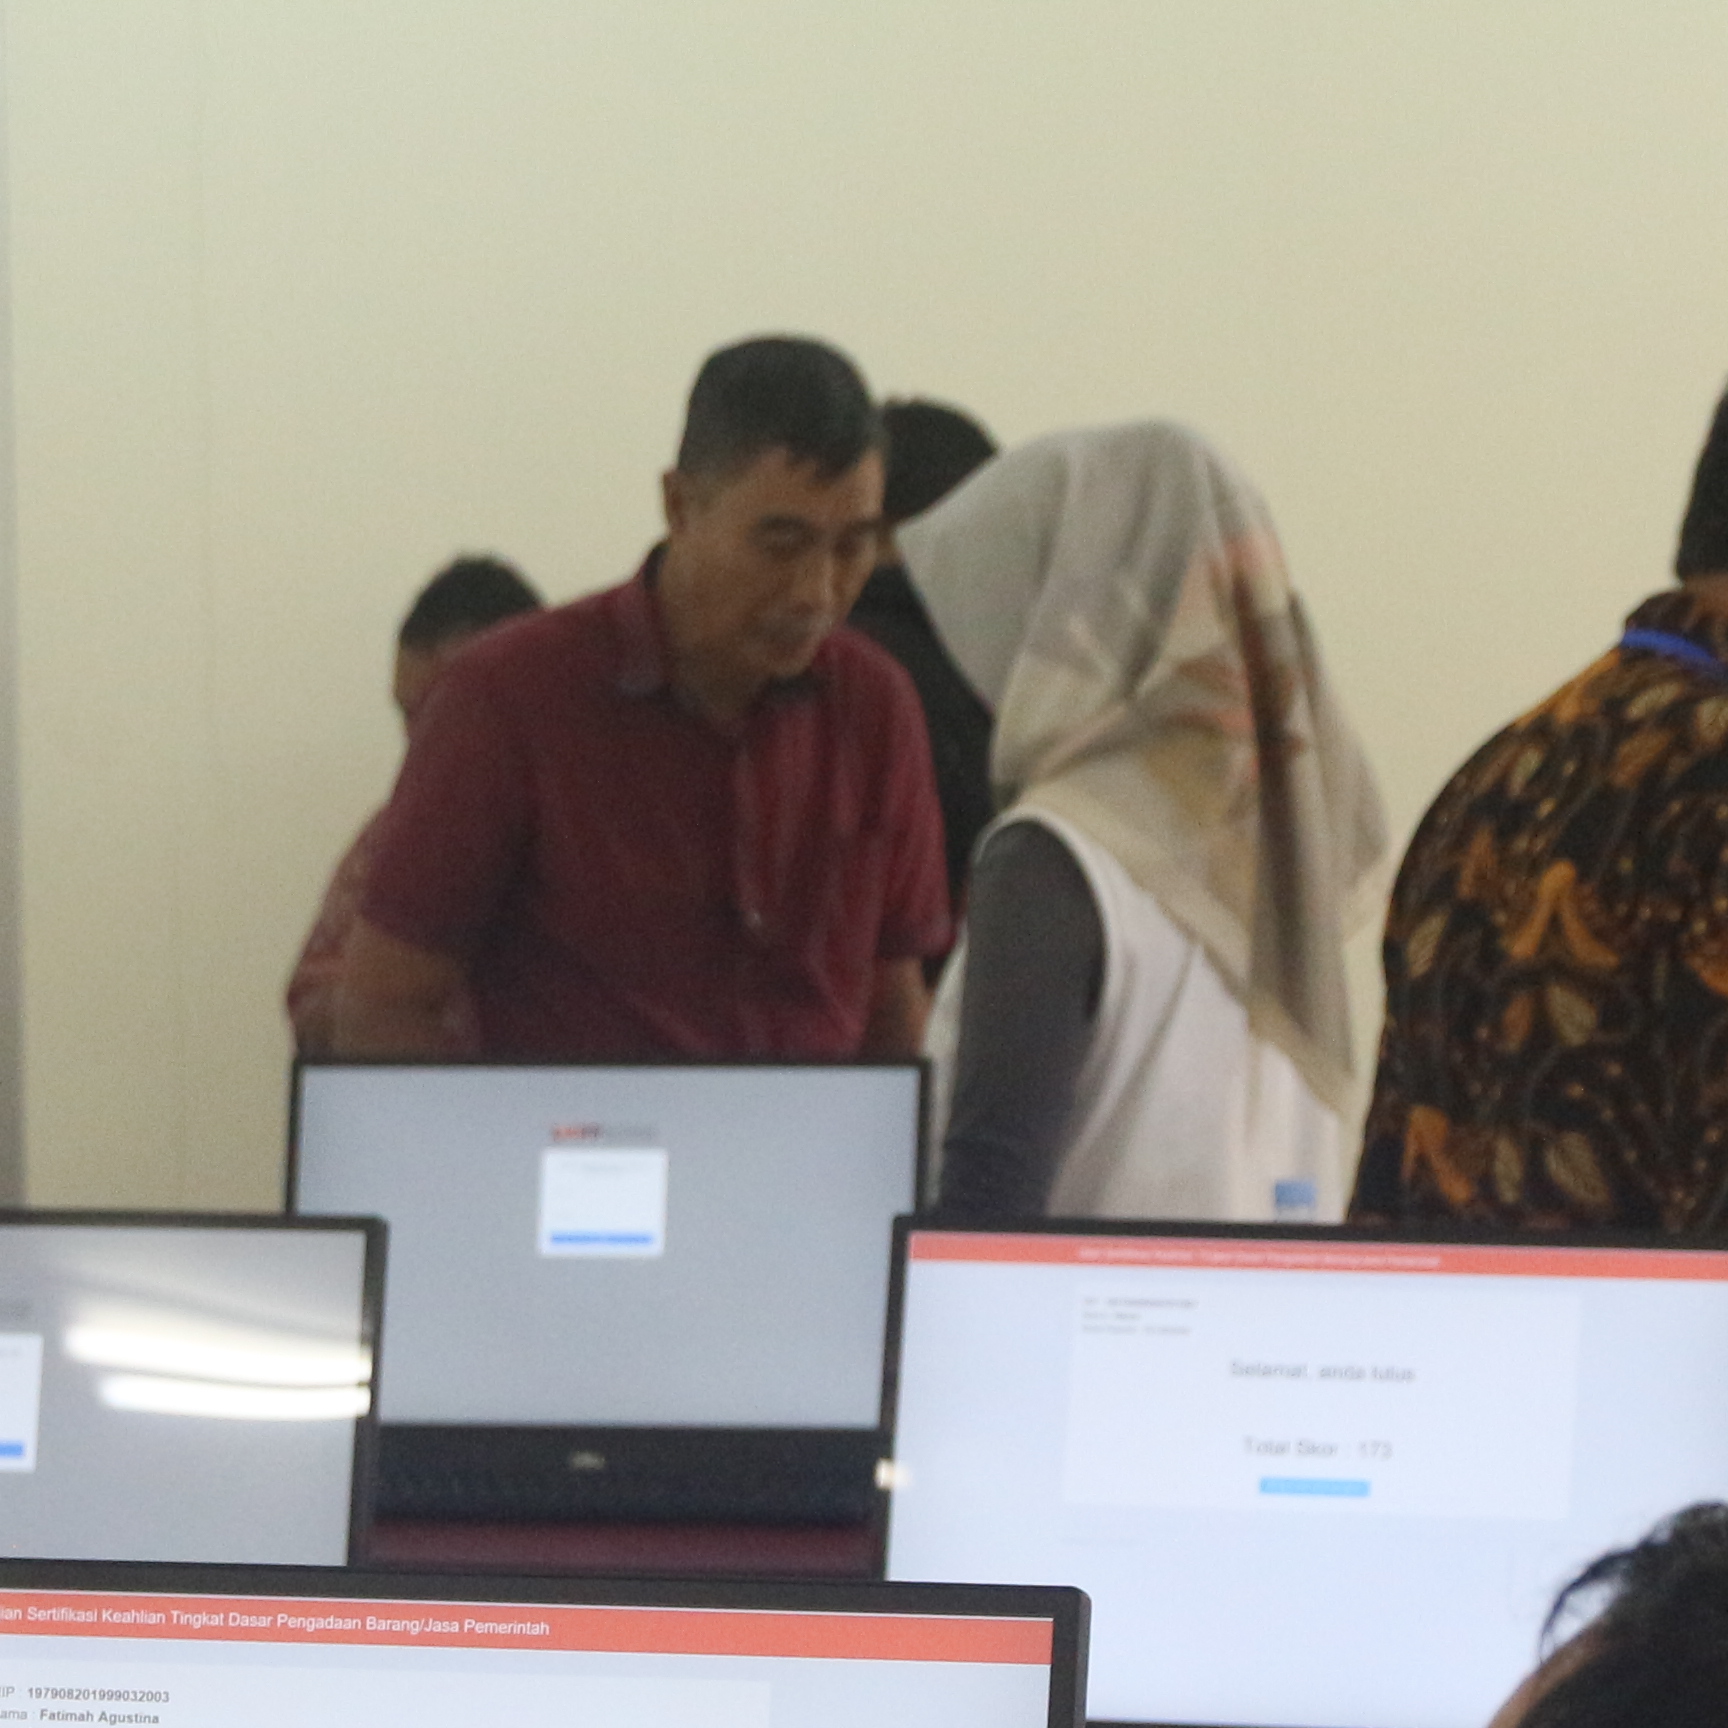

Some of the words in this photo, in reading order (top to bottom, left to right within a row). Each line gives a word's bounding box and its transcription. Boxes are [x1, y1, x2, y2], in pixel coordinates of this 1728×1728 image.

[27, 1606, 98, 1622] Sertifikasi
[102, 1608, 166, 1624] Keahlian
[171, 1609, 224, 1629] Tingkat
[228, 1611, 273, 1627] Dasar
[277, 1613, 362, 1632] Pengadaan
[365, 1616, 460, 1635] Barang/Jasa
[463, 1618, 550, 1636] Pemerintah
[39, 1708, 95, 1723] Fatimah
[97, 1710, 160, 1726] Agustina
